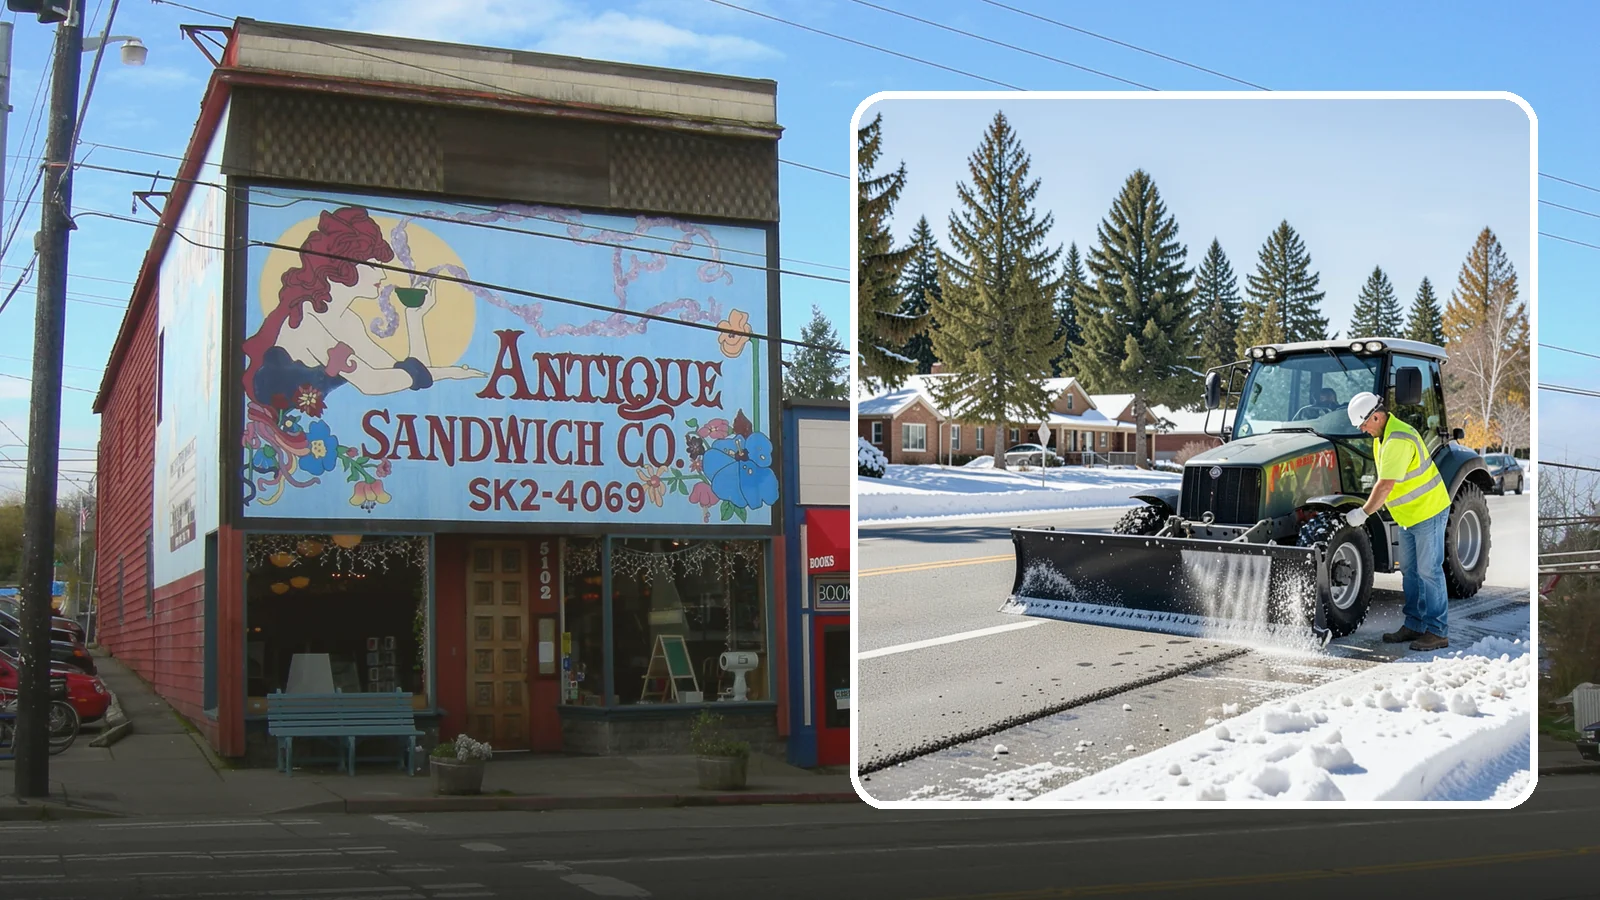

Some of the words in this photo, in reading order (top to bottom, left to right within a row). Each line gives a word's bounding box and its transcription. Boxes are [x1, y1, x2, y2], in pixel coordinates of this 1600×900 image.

[475, 329, 723, 421] ANTIQUE
[361, 408, 604, 467] SANDWICH
[617, 422, 685, 469] CO.
[468, 477, 645, 513] SK2-4069
[539, 542, 552, 599] 5102
[809, 555, 834, 569] BOOKS
